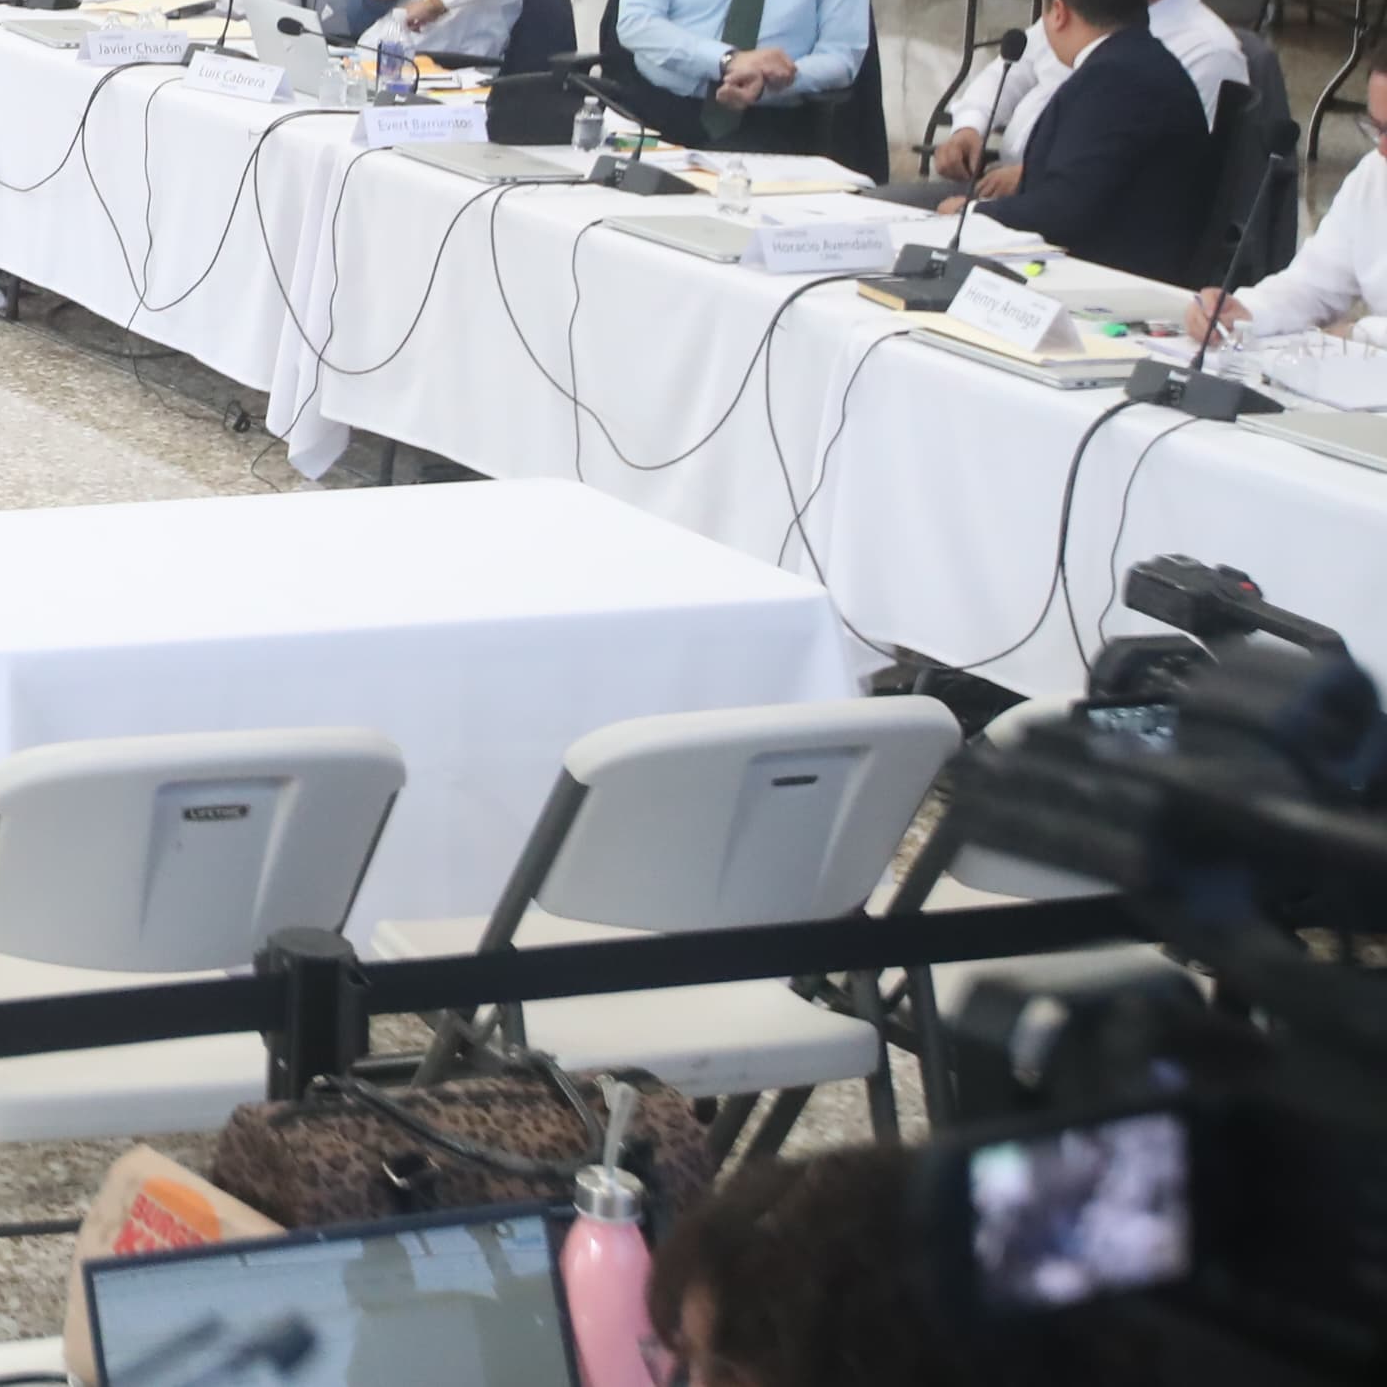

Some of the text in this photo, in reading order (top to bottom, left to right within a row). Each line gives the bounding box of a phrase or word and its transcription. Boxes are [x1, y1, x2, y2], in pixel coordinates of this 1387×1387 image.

[98, 41, 183, 56] Javier Chacón
[198, 66, 221, 80] Luis
[222, 68, 267, 88] Cabrera
